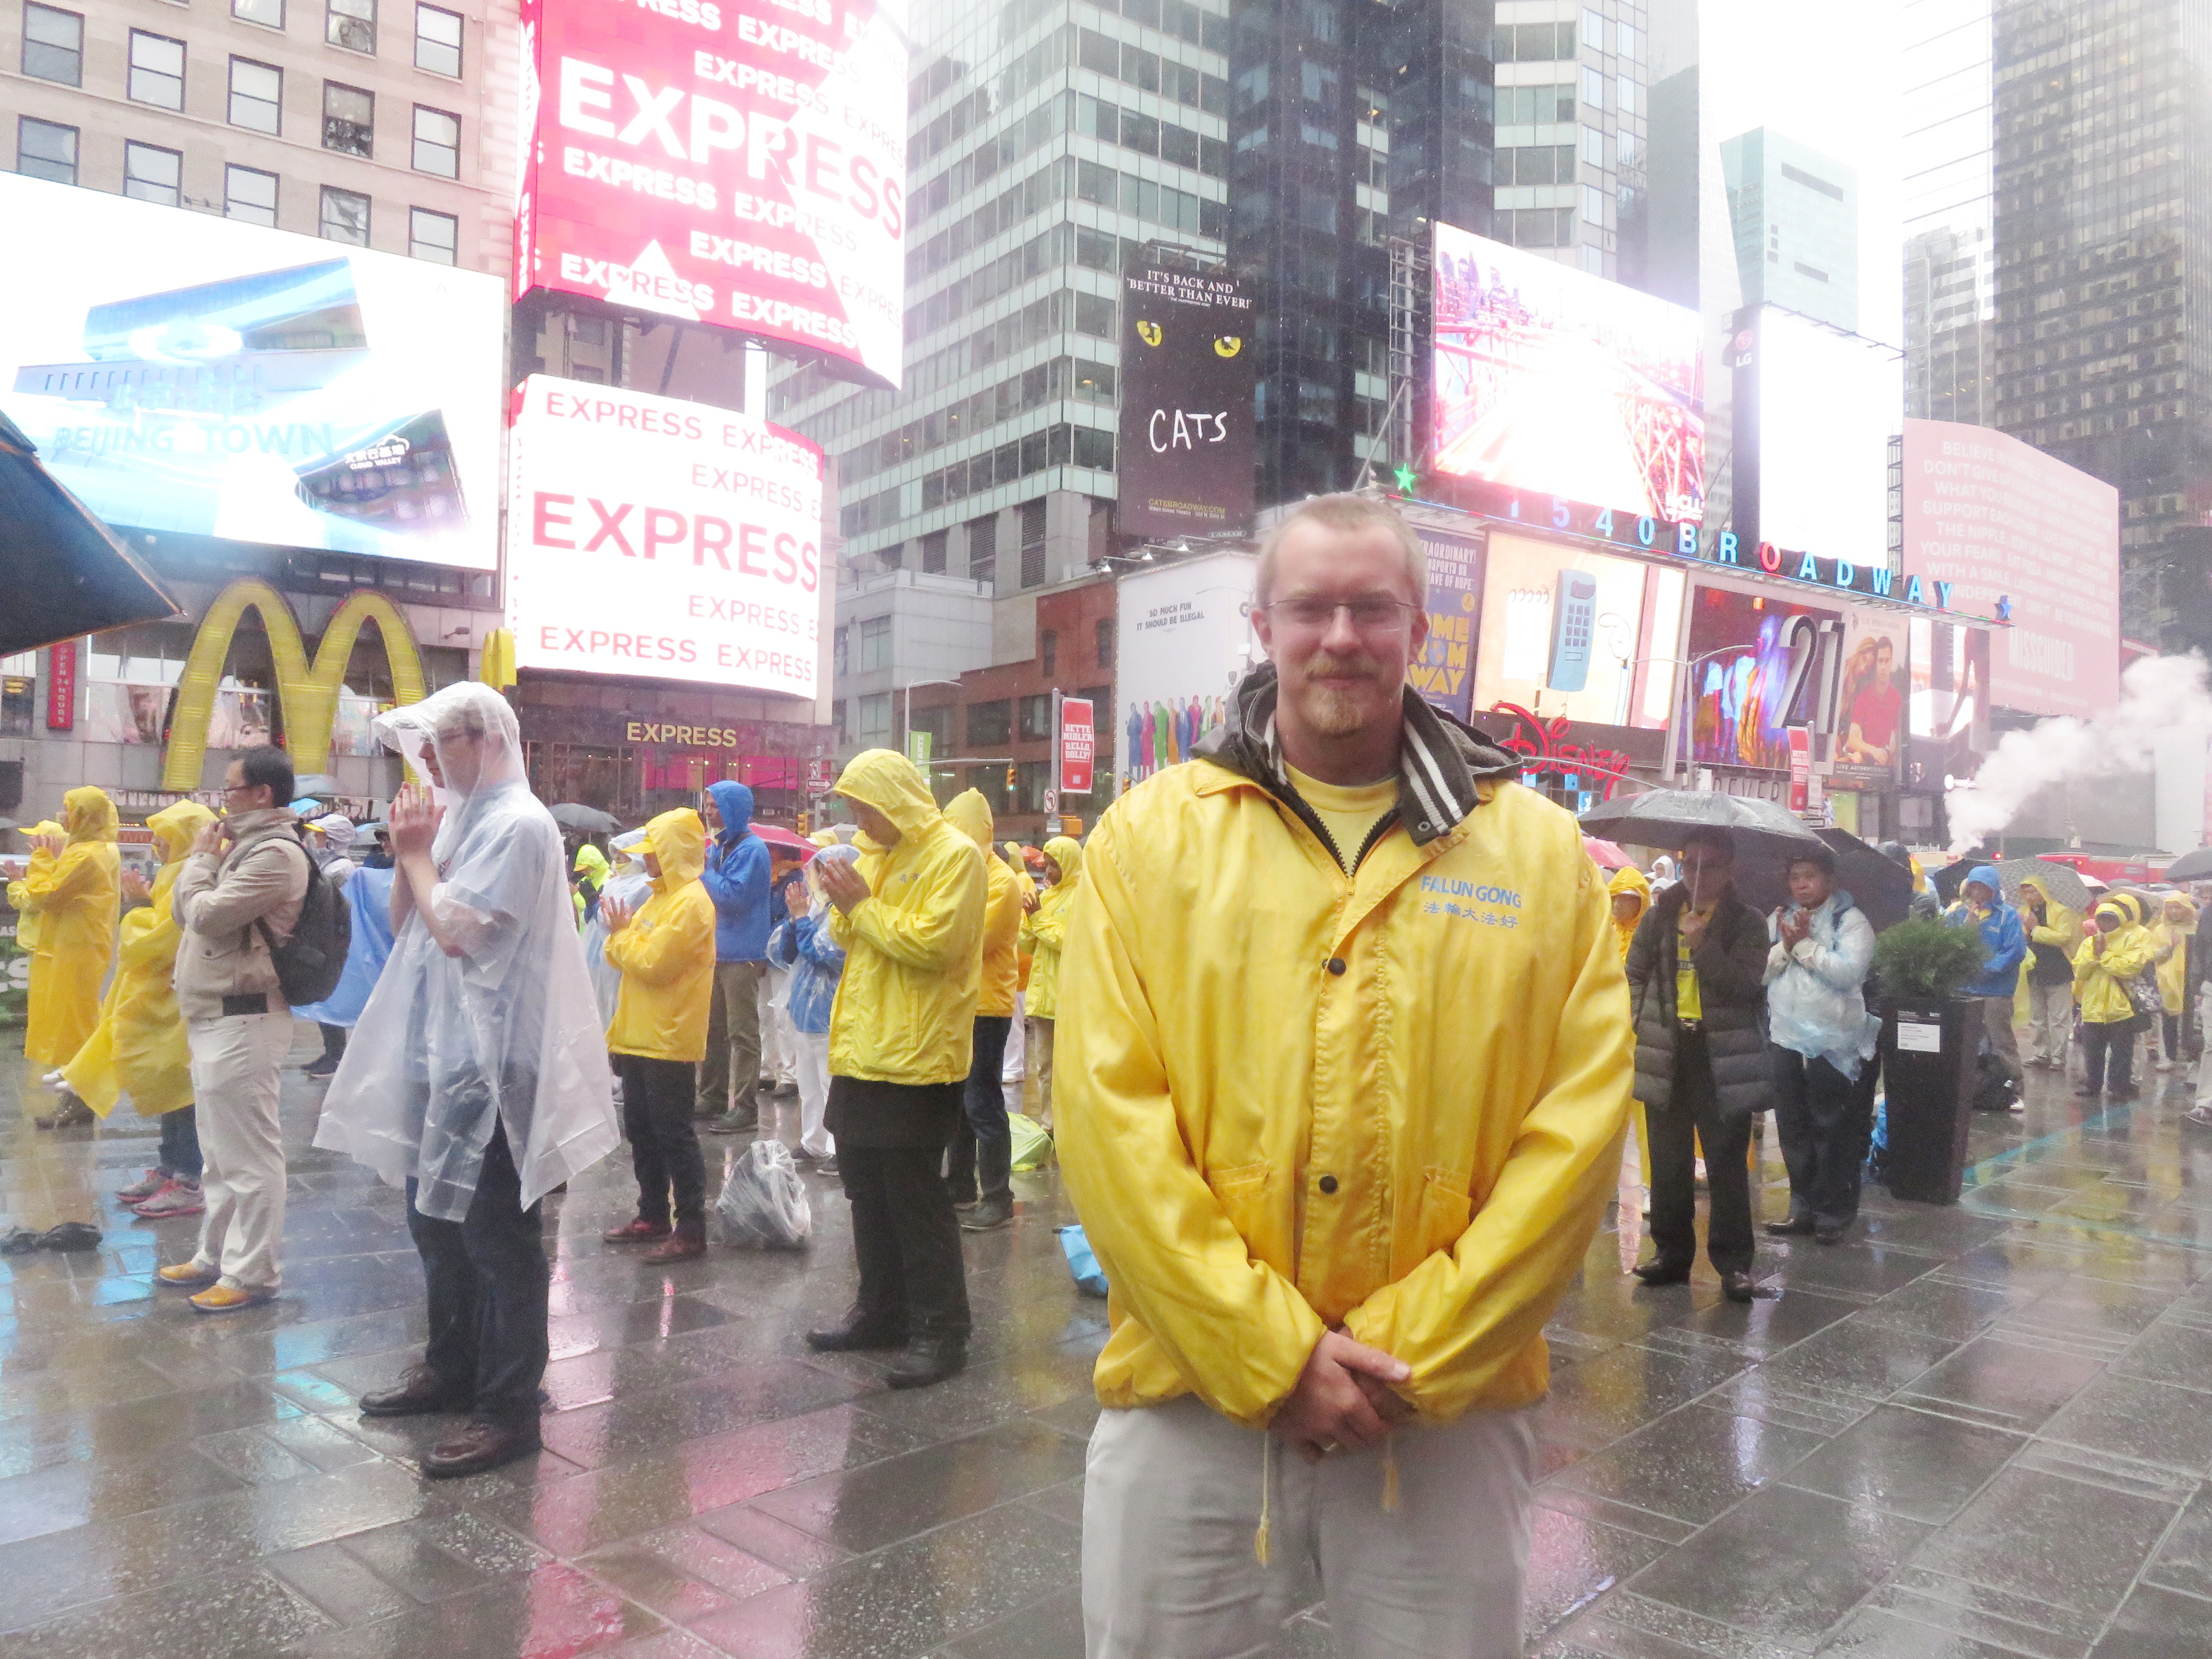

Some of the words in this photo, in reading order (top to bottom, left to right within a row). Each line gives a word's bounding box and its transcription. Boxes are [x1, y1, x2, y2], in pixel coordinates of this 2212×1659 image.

[738, 14, 861, 84] EXPRESS
[695, 50, 829, 115] EXPRESS
[560, 56, 902, 240] EXPRESS
[564, 147, 717, 209] EXPRESS
[735, 192, 857, 252] EXPRESS
[691, 231, 827, 288] EXPRESS
[1148, 270, 1169, 283] IT'S
[1173, 275, 1204, 289] BACK
[1207, 281, 1233, 293] AND
[561, 253, 714, 311] EXPRESS
[733, 292, 856, 349] EXPRESS
[1178, 288, 1213, 303] THAN
[1735, 353, 1753, 367] LG
[54, 426, 175, 456] BEIJING
[203, 424, 334, 455] TOWN
[546, 391, 702, 440] EXPRESS
[723, 425, 817, 476] EXPRESS
[1150, 409, 1227, 453] CATS
[349, 461, 373, 470] CLOUD
[374, 457, 401, 466] VALLEY
[1943, 441, 1995, 461] BELIEVE
[1924, 460, 1969, 477] DON'T
[1972, 466, 1998, 485] GIVE
[692, 463, 803, 512] EXPRESS
[1934, 481, 1980, 499] WHAT
[1980, 485, 2002, 504] YOU
[1149, 498, 1225, 514] CATSBROADWAY.COM
[1923, 500, 1988, 519] SUPPORT
[1990, 508, 2013, 527] EACH
[532, 491, 817, 592] EXPRESS
[1936, 522, 1965, 537] THE
[1968, 525, 2006, 544] NIPPLE
[1679, 523, 1953, 608] BROADWAY
[1920, 541, 1962, 557] YOUR
[1965, 545, 2001, 563] FEARS
[1926, 561, 1965, 578] WITH
[1969, 565, 1977, 578] A
[688, 594, 799, 635] EXPRESS
[1137, 623, 1142, 631] IT
[1145, 618, 1167, 629] SHOULD
[1169, 616, 1177, 624] BE
[1180, 611, 1204, 622] ILLEGAL
[1149, 609, 1157, 617] SO
[1160, 605, 1177, 615] MUCH
[1180, 602, 1191, 611] FUN
[540, 626, 697, 662] EXPRESS
[718, 643, 812, 682] EXPRESS
[1771, 615, 1845, 733] 21
[58, 687, 66, 723] HOURS
[627, 722, 737, 747] EXPRESS
[1063, 732, 1093, 742] MIDLER
[1065, 724, 1091, 733] BETTE
[1421, 876, 1474, 898] FALUN
[1476, 885, 1521, 908] GONG
[1424, 901, 1518, 928] 法輪大法好
